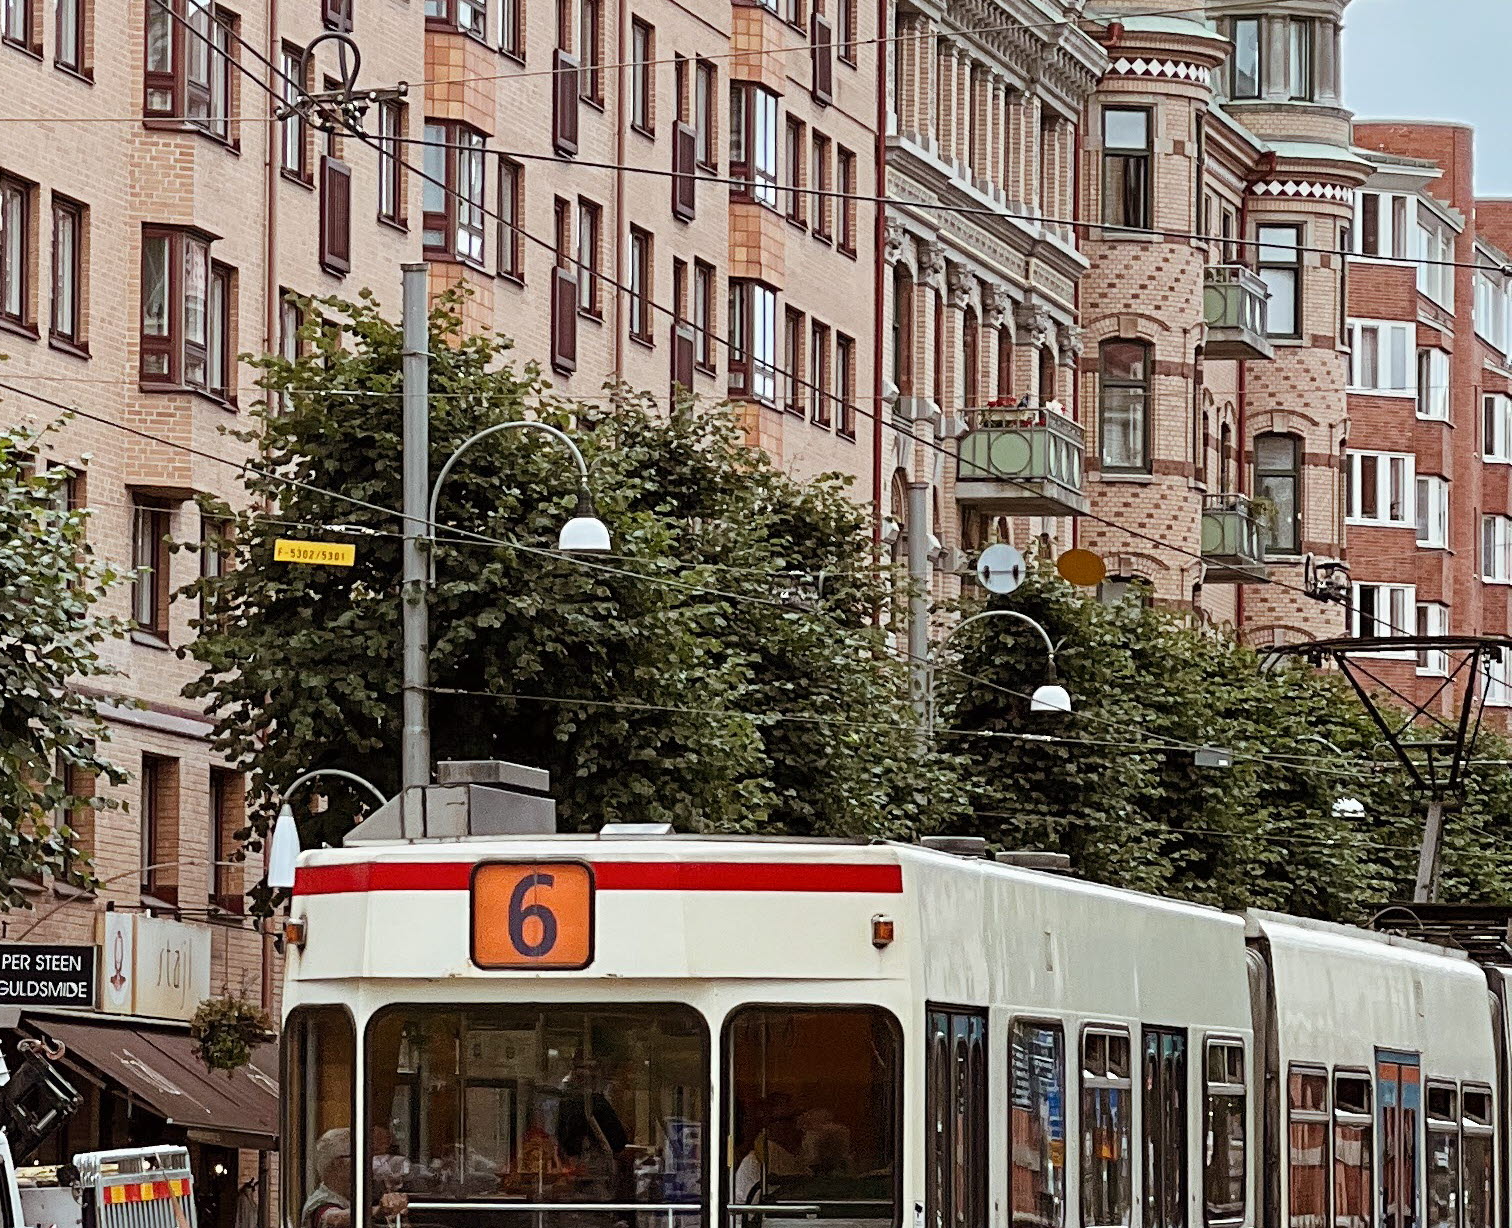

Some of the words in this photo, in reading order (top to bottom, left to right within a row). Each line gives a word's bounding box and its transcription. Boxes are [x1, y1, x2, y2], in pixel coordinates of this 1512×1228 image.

[508, 873, 558, 957] 6
[1, 953, 31, 971] PER
[35, 955, 82, 972] STEEN
